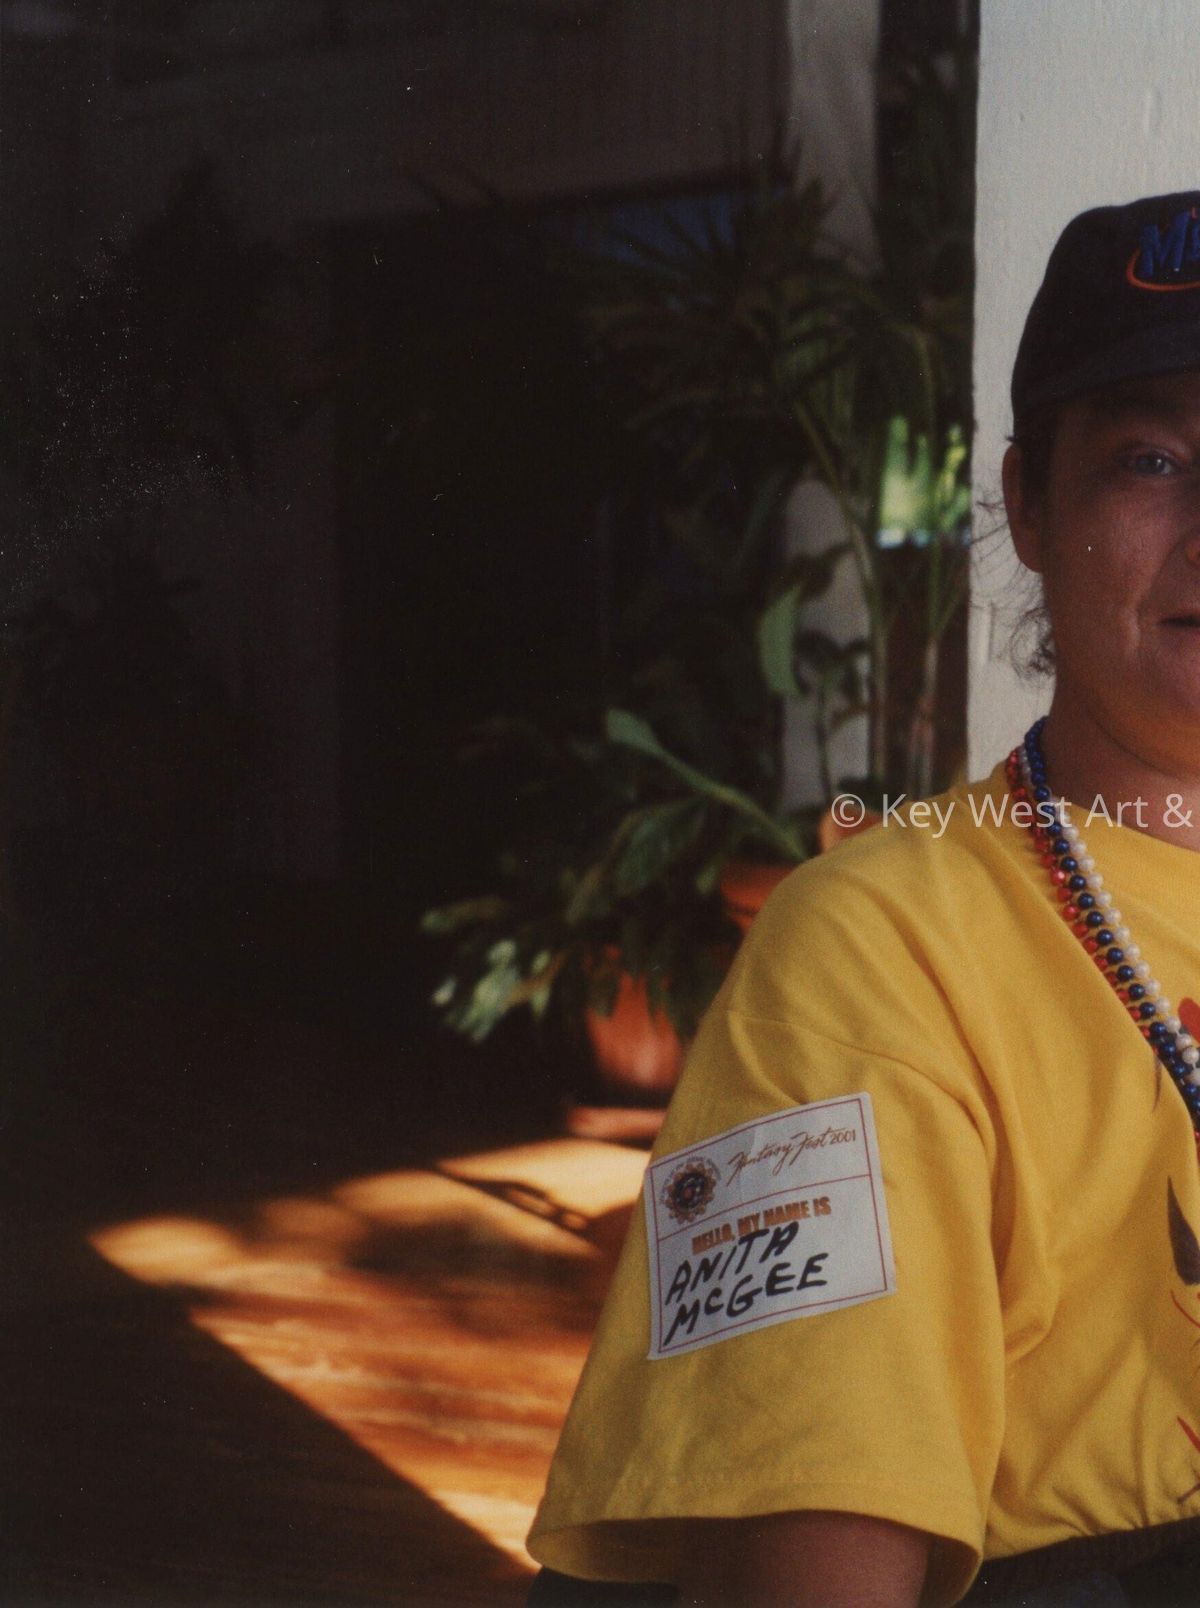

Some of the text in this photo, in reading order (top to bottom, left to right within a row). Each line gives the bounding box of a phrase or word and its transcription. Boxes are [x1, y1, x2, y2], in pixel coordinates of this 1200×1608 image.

[726, 1143, 793, 1187] Fantasy
[788, 1125, 846, 1167] Fest
[829, 1129, 856, 1146] 2001
[691, 1196, 832, 1255] HELLO, MY NAME IS
[665, 1221, 799, 1306] ANITA
